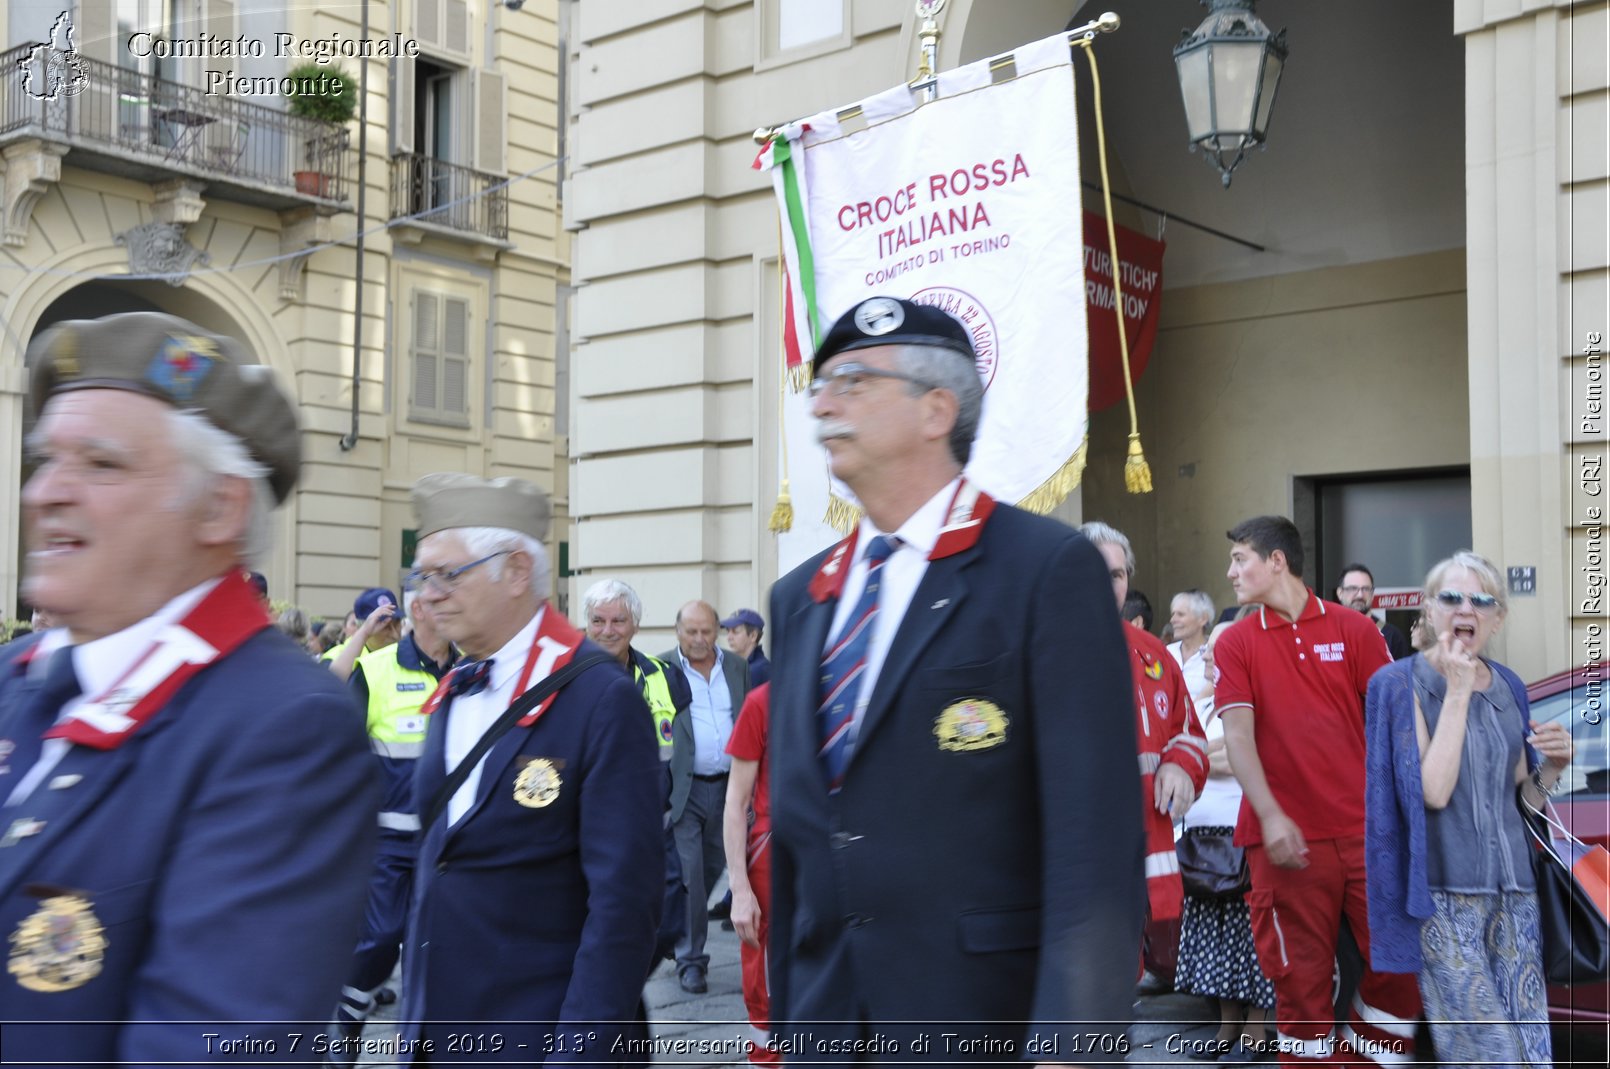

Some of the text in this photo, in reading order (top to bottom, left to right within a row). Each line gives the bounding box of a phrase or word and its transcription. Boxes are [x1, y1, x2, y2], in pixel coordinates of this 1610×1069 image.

[837, 153, 1030, 232] CROCE ROSSA
[865, 234, 1010, 286] COMITATO DI TORINO
[878, 201, 991, 259] ITALIANA
[960, 304, 979, 324] 22
[971, 322, 993, 374] AGOSTO
